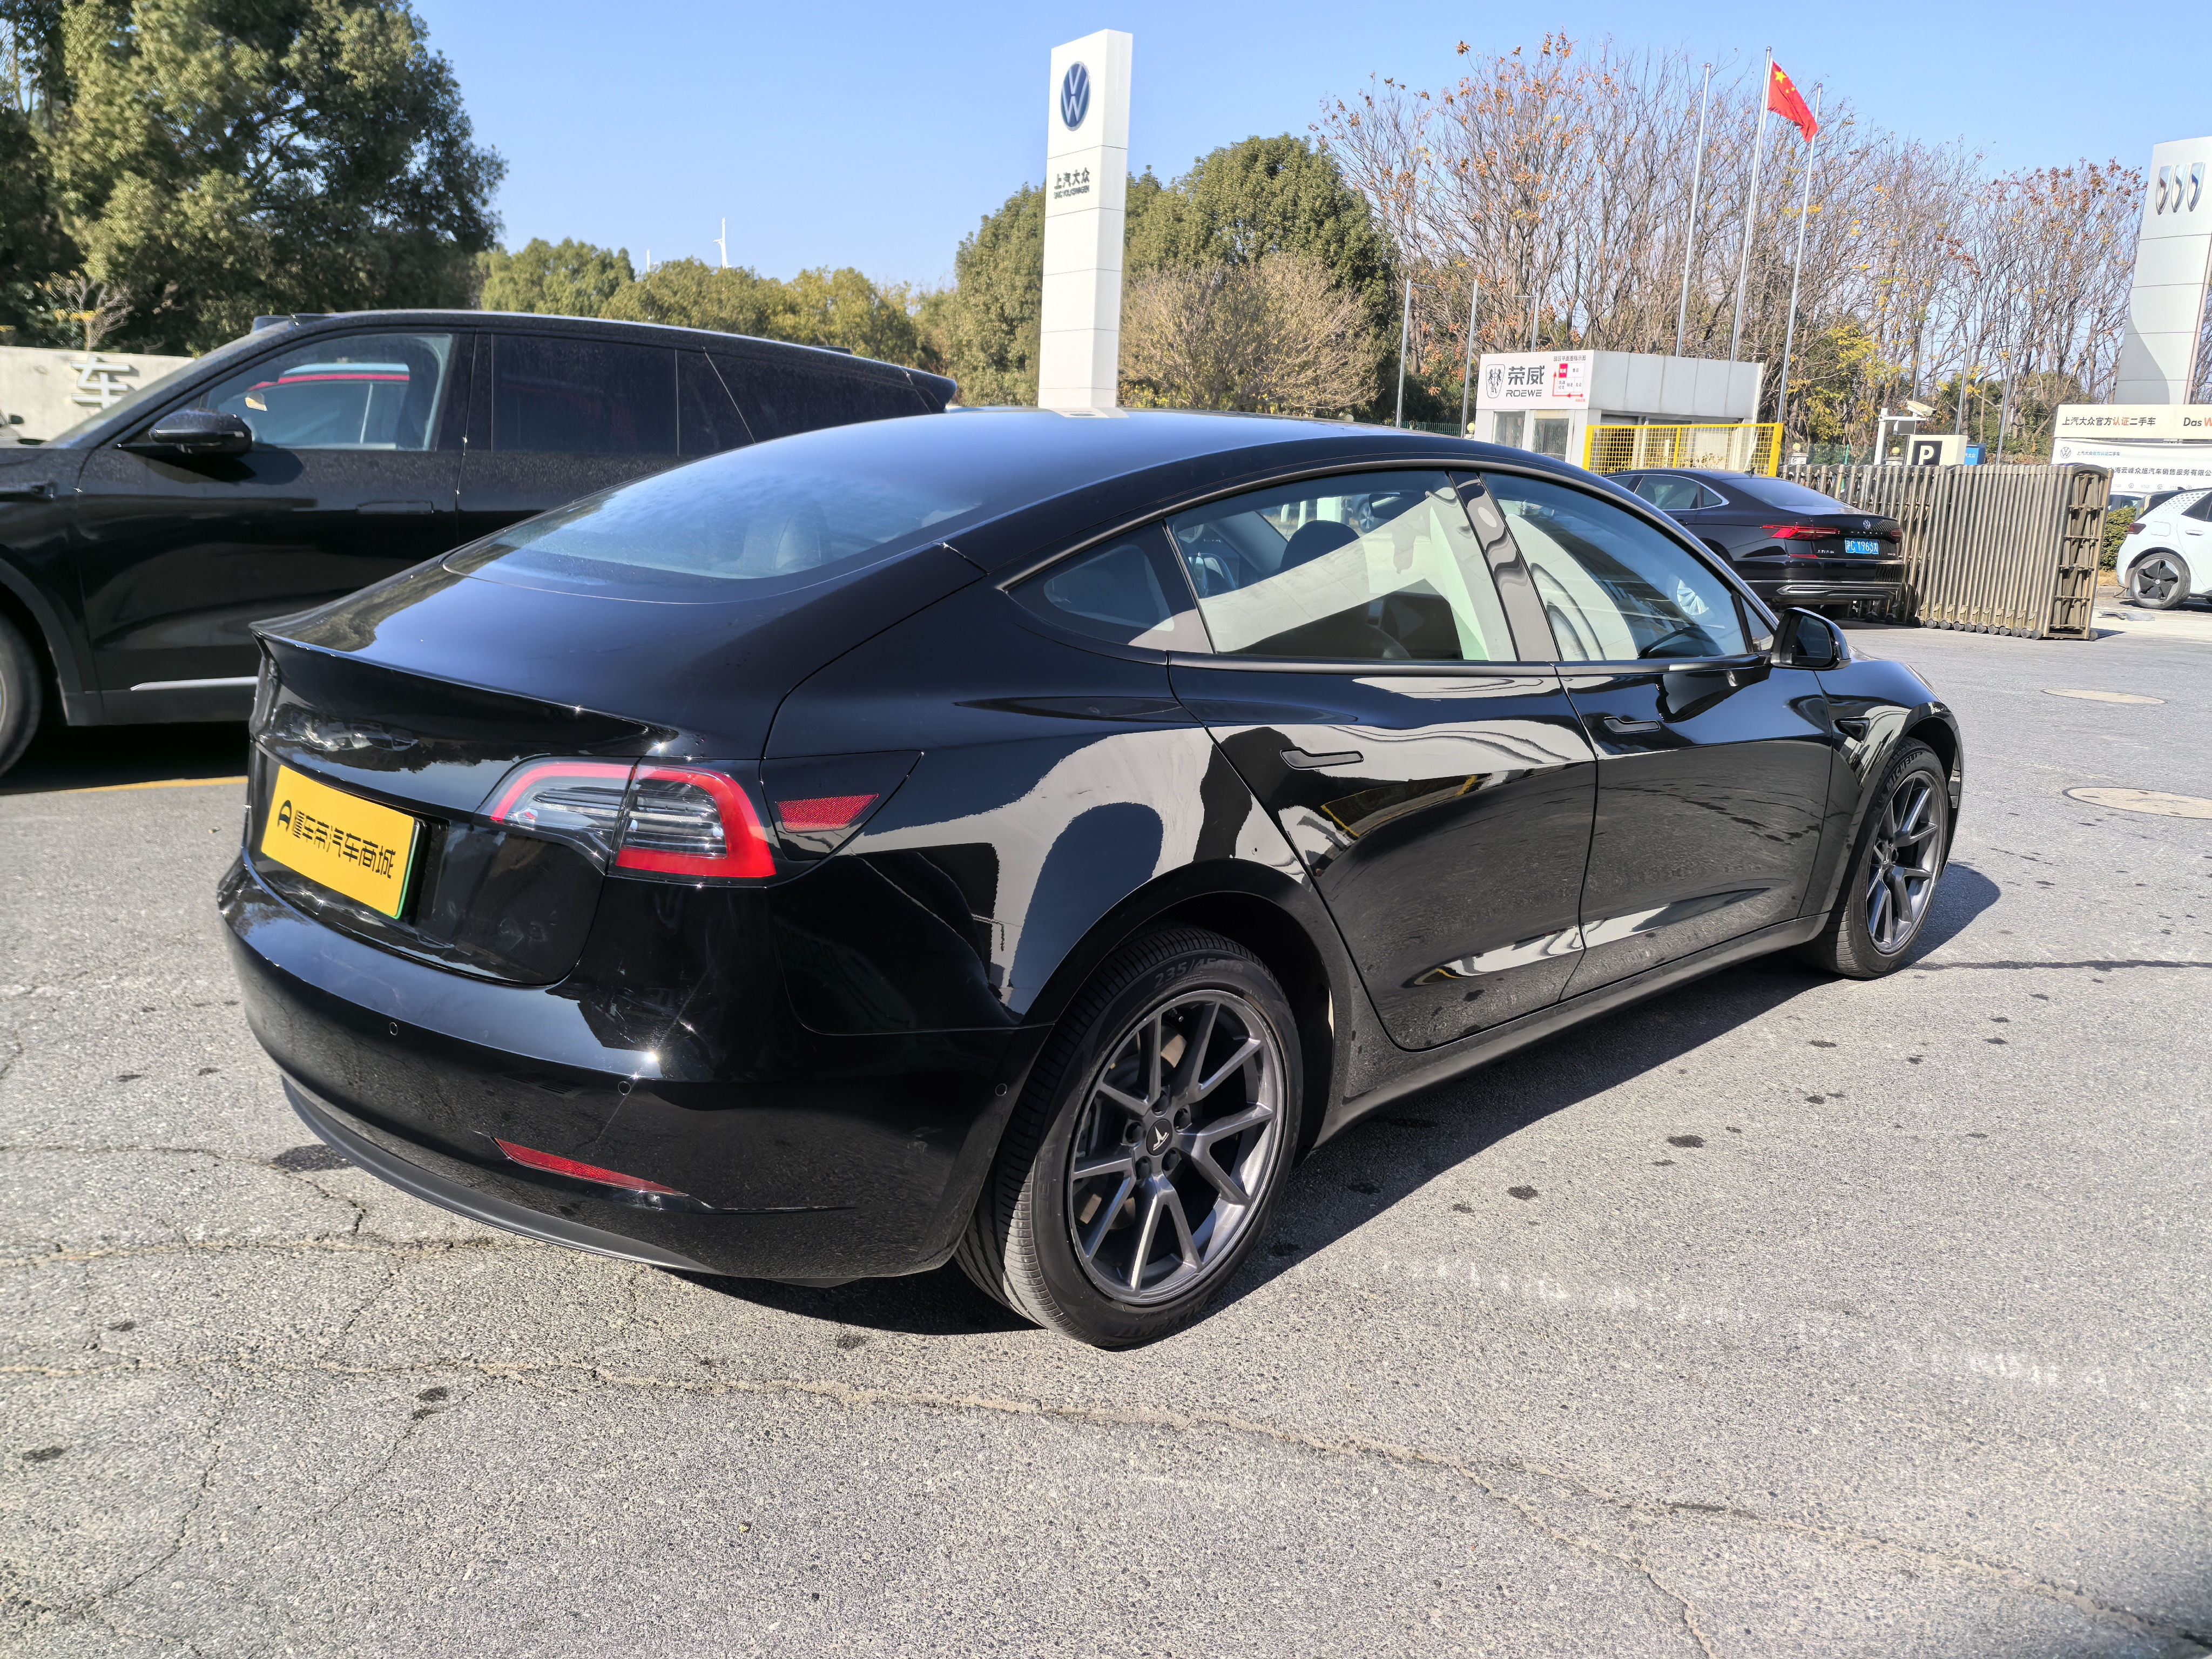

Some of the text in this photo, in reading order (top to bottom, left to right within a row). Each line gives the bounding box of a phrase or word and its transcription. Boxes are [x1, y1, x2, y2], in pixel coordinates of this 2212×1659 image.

[1054, 167, 1090, 190] 上汽大众
[71, 356, 130, 409] 车
[1508, 366, 1545, 385] 荣威
[2062, 416, 2156, 426] 上汽大众官方认证二手车
[2183, 417, 2202, 427] Das
[1918, 445, 1934, 466] P
[292, 810, 396, 879] 懂车帝汽车商城
